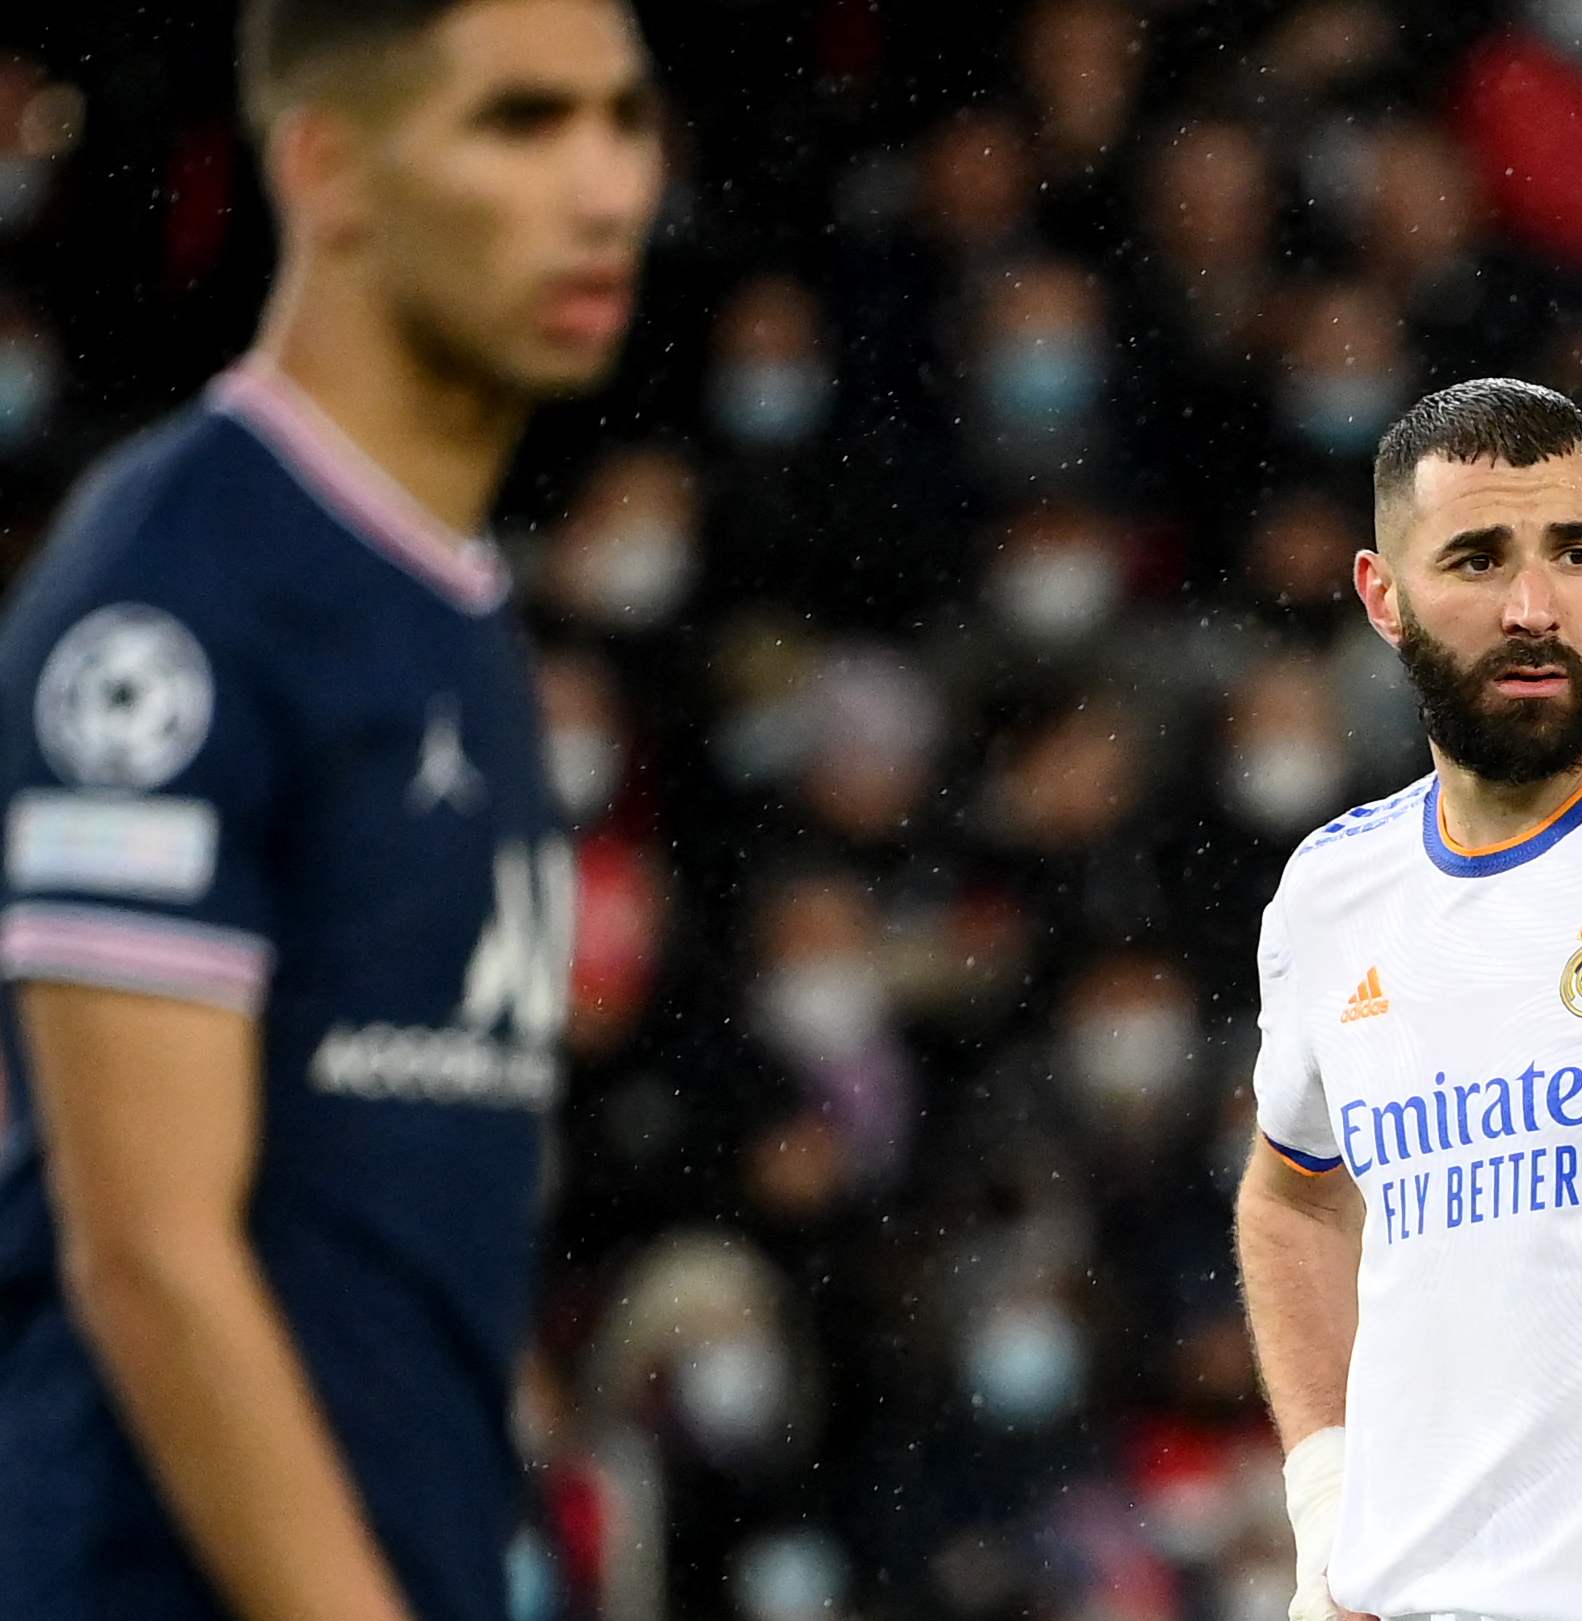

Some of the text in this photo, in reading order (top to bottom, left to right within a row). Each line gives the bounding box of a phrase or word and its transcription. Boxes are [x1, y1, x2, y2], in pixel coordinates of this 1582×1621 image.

[1340, 999, 1390, 1024] adidas
[1382, 1145, 1580, 1245] FLY BETTER
